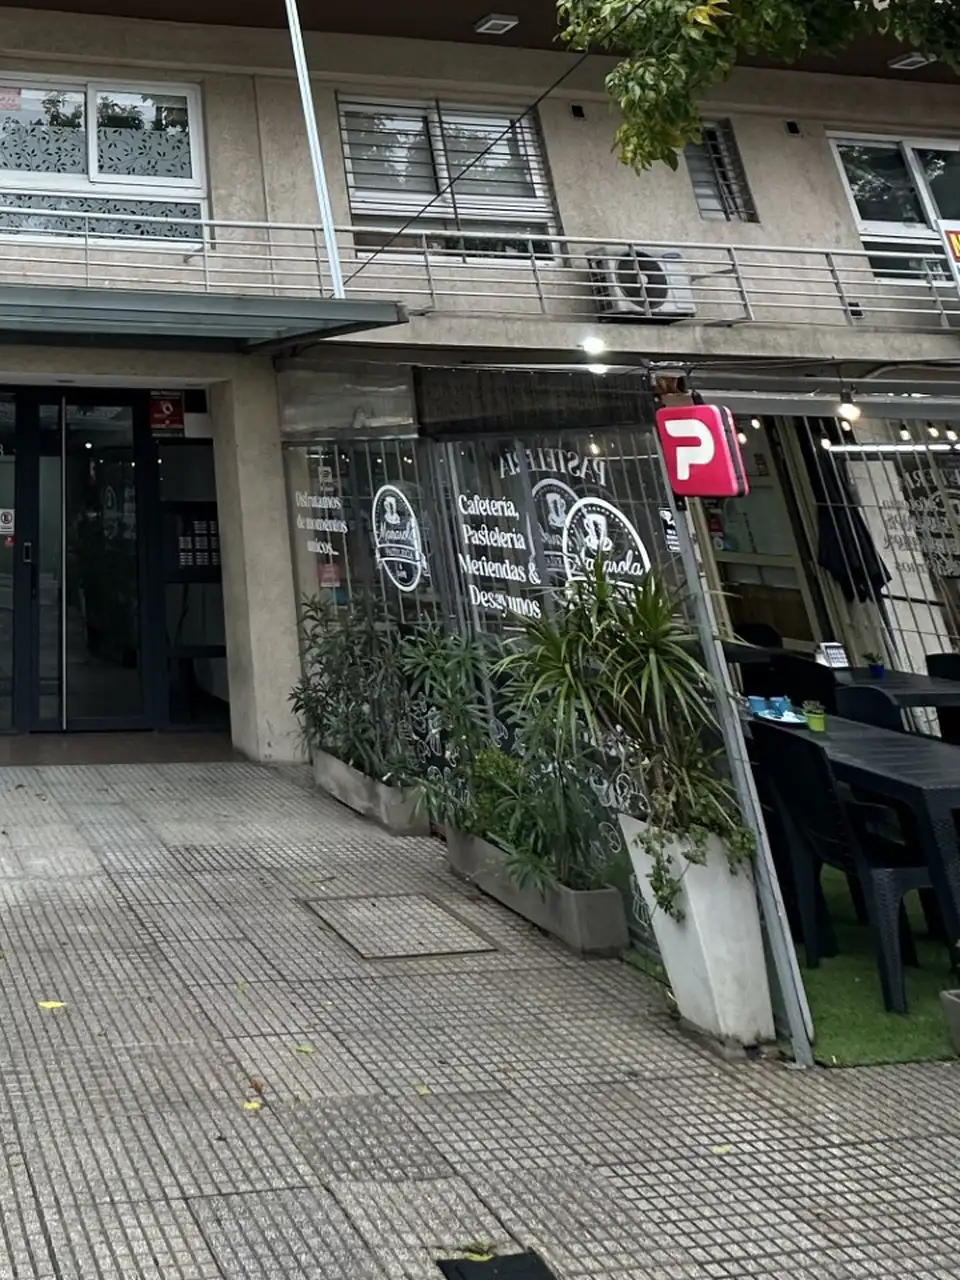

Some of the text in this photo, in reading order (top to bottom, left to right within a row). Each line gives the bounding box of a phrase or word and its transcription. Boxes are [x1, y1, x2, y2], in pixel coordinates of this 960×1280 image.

[664, 419, 715, 480] P
[458, 553, 541, 585] Meriendas &
[567, 548, 645, 578] aarola
[468, 584, 542, 619] Desayunos
